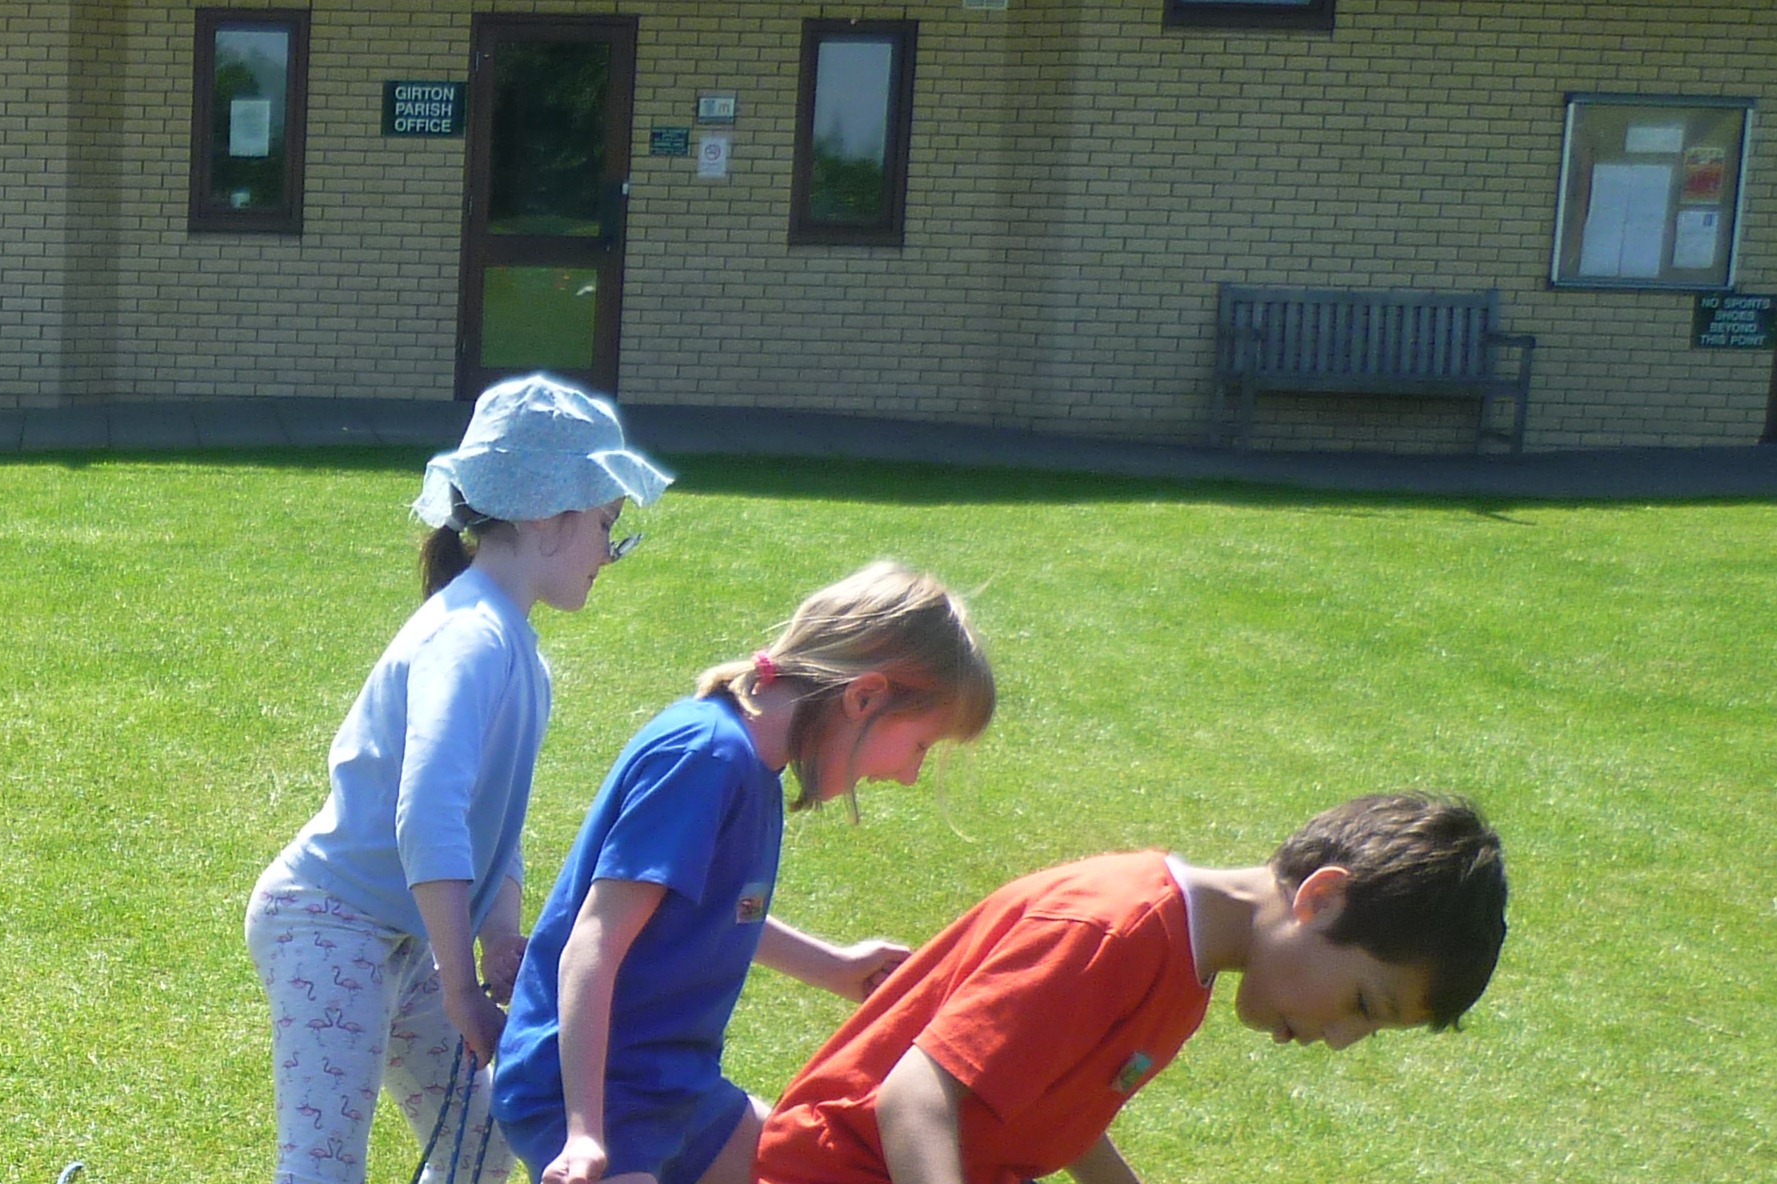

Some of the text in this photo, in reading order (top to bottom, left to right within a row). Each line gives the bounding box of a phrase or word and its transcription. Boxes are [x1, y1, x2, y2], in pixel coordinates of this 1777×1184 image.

[395, 86, 455, 101] GIRTON
[395, 102, 453, 117] PARISH
[394, 118, 452, 133] OFFICE
[1701, 297, 1771, 310] NO SPORTS
[1714, 310, 1756, 321] SHOES
[1709, 322, 1757, 334] BEYOND
[1700, 334, 1766, 346] THIS POINT
